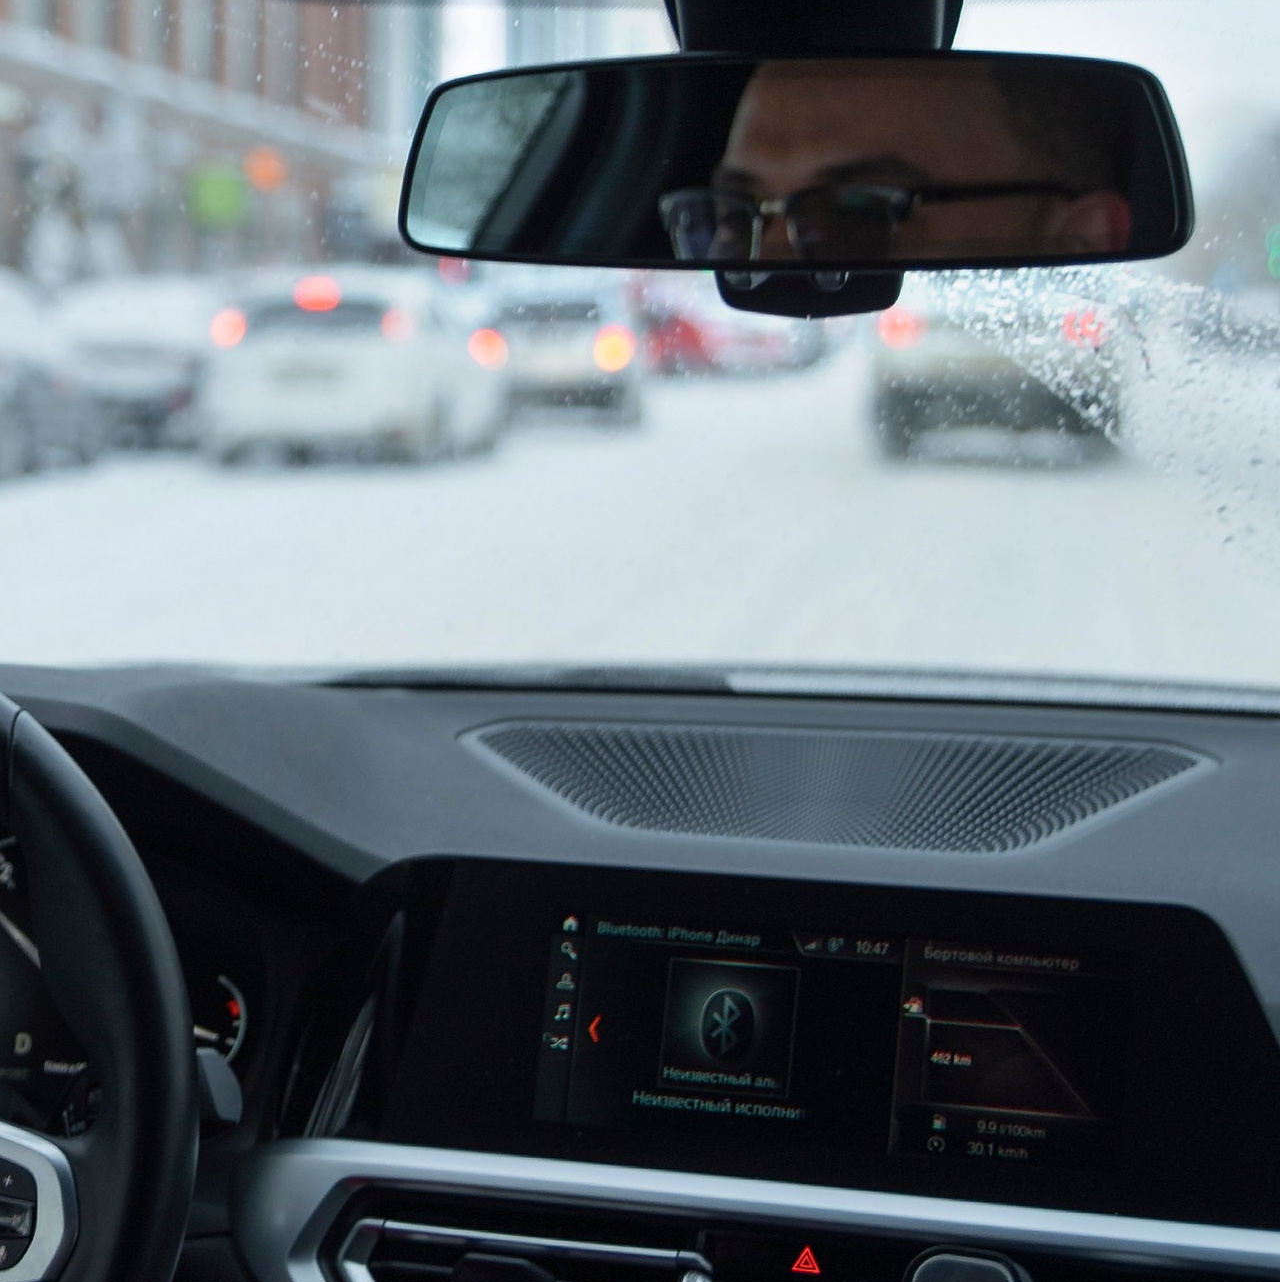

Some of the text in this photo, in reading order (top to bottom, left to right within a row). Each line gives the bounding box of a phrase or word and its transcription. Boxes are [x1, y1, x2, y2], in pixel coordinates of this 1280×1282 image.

[668, 926, 714, 943] iPhone
[855, 940, 890, 955] 10:47
[924, 945, 1080, 971] Бортовой компьютер
[14, 1031, 33, 1055] D
[953, 1053, 972, 1067] km
[662, 1066, 752, 1087] Неизвестный
[632, 1090, 732, 1114] Неизвестный
